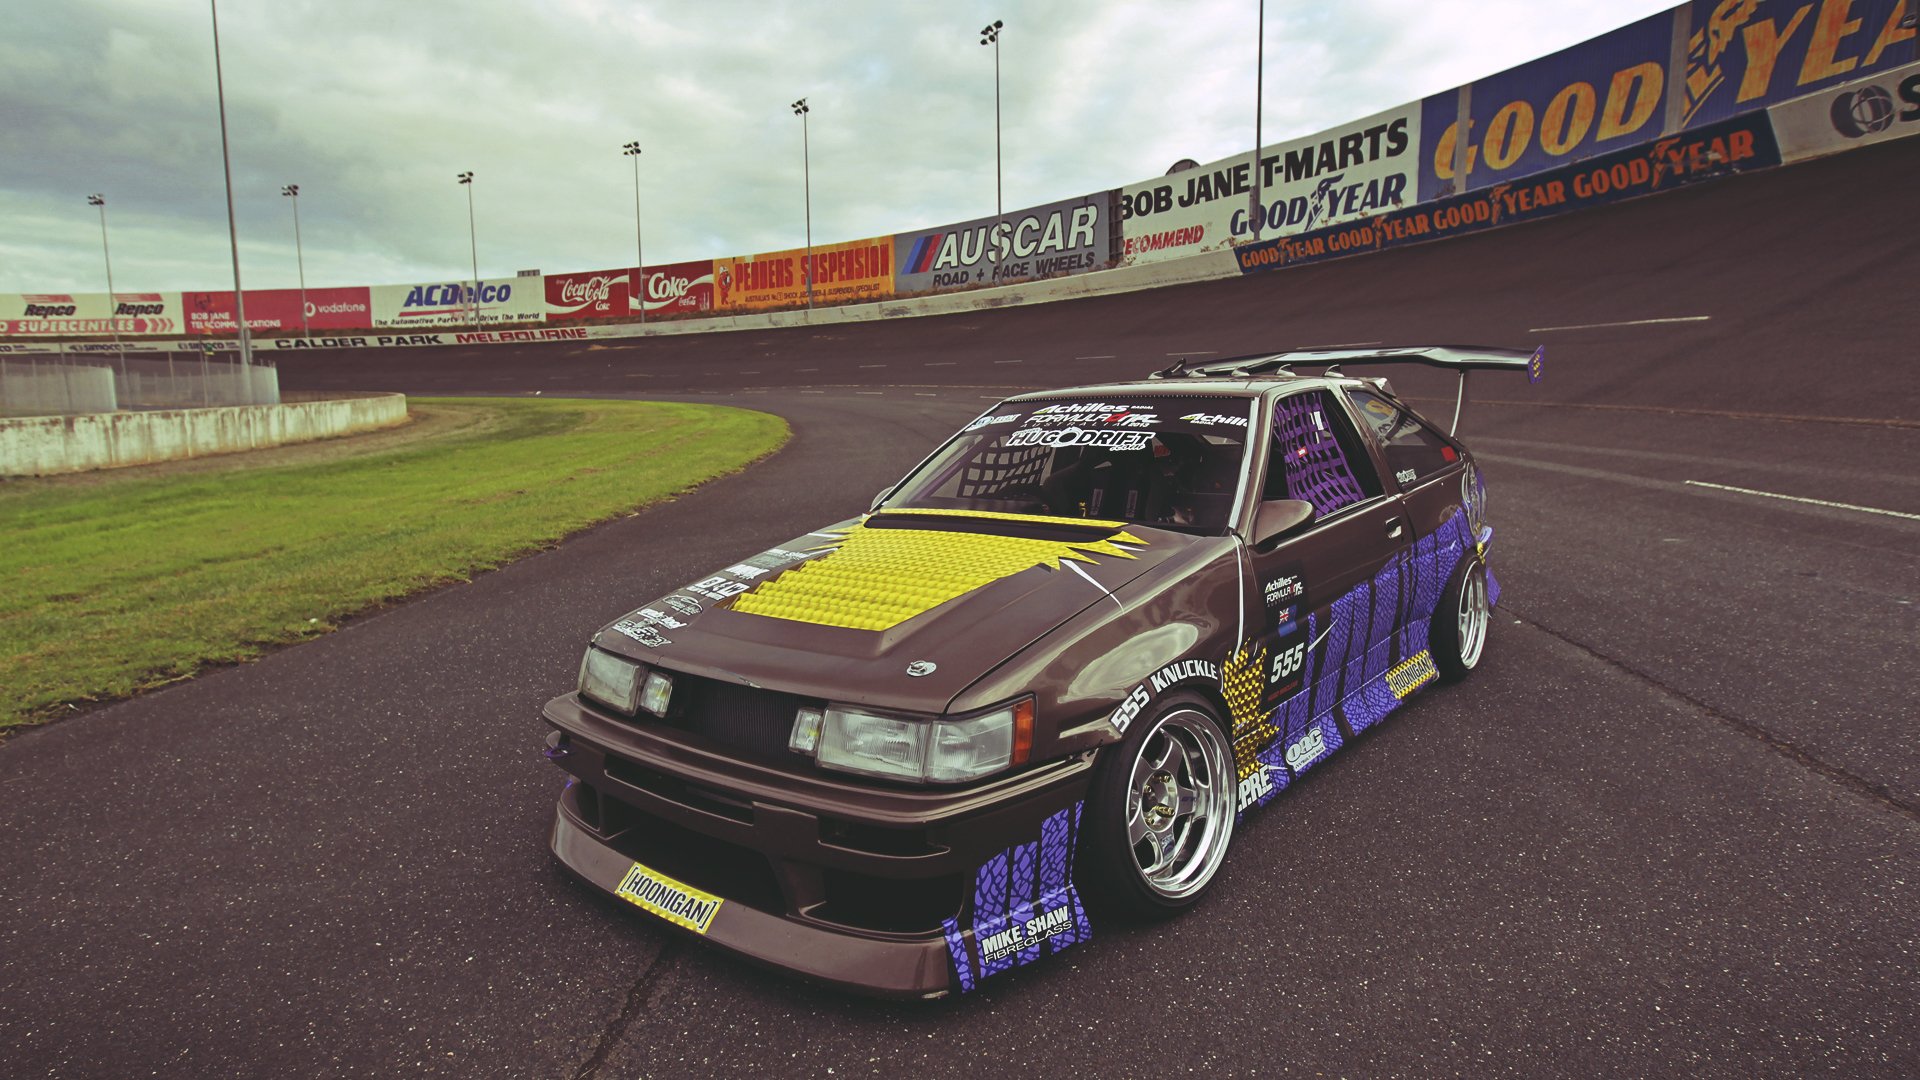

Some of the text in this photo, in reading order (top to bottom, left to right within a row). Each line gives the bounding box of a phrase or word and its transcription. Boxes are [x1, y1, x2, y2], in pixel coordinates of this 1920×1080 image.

[1122, 117, 1409, 220] BOB JANE T-MARTS
[932, 204, 1099, 271] AUSCAR
[1121, 224, 1204, 255] ECOMMEND
[735, 244, 890, 292] PEDDERS SUSPENSION
[933, 271, 970, 287] ROAD
[992, 262, 1029, 280] RACE
[1036, 252, 1095, 274] WHEELS
[403, 281, 512, 307] ACDelco
[648, 273, 689, 299] Coke
[24, 304, 76, 318] Repco
[115, 303, 164, 317] Repco
[318, 302, 367, 313] vodafone
[391, 317, 434, 326] Automotive
[517, 312, 540, 320] World
[191, 319, 281, 330] TELECOMMUICATIONS
[275, 328, 588, 349] CALDER PARK MELBOURNE
[1032, 403, 1130, 414] Achilles
[1270, 642, 1305, 684] 555
[1111, 684, 1151, 733] 555
[1150, 659, 1219, 694] KNUCKLE
[982, 905, 1069, 956] MIKE SHAW
[984, 920, 1073, 964] FIBREGLASS
